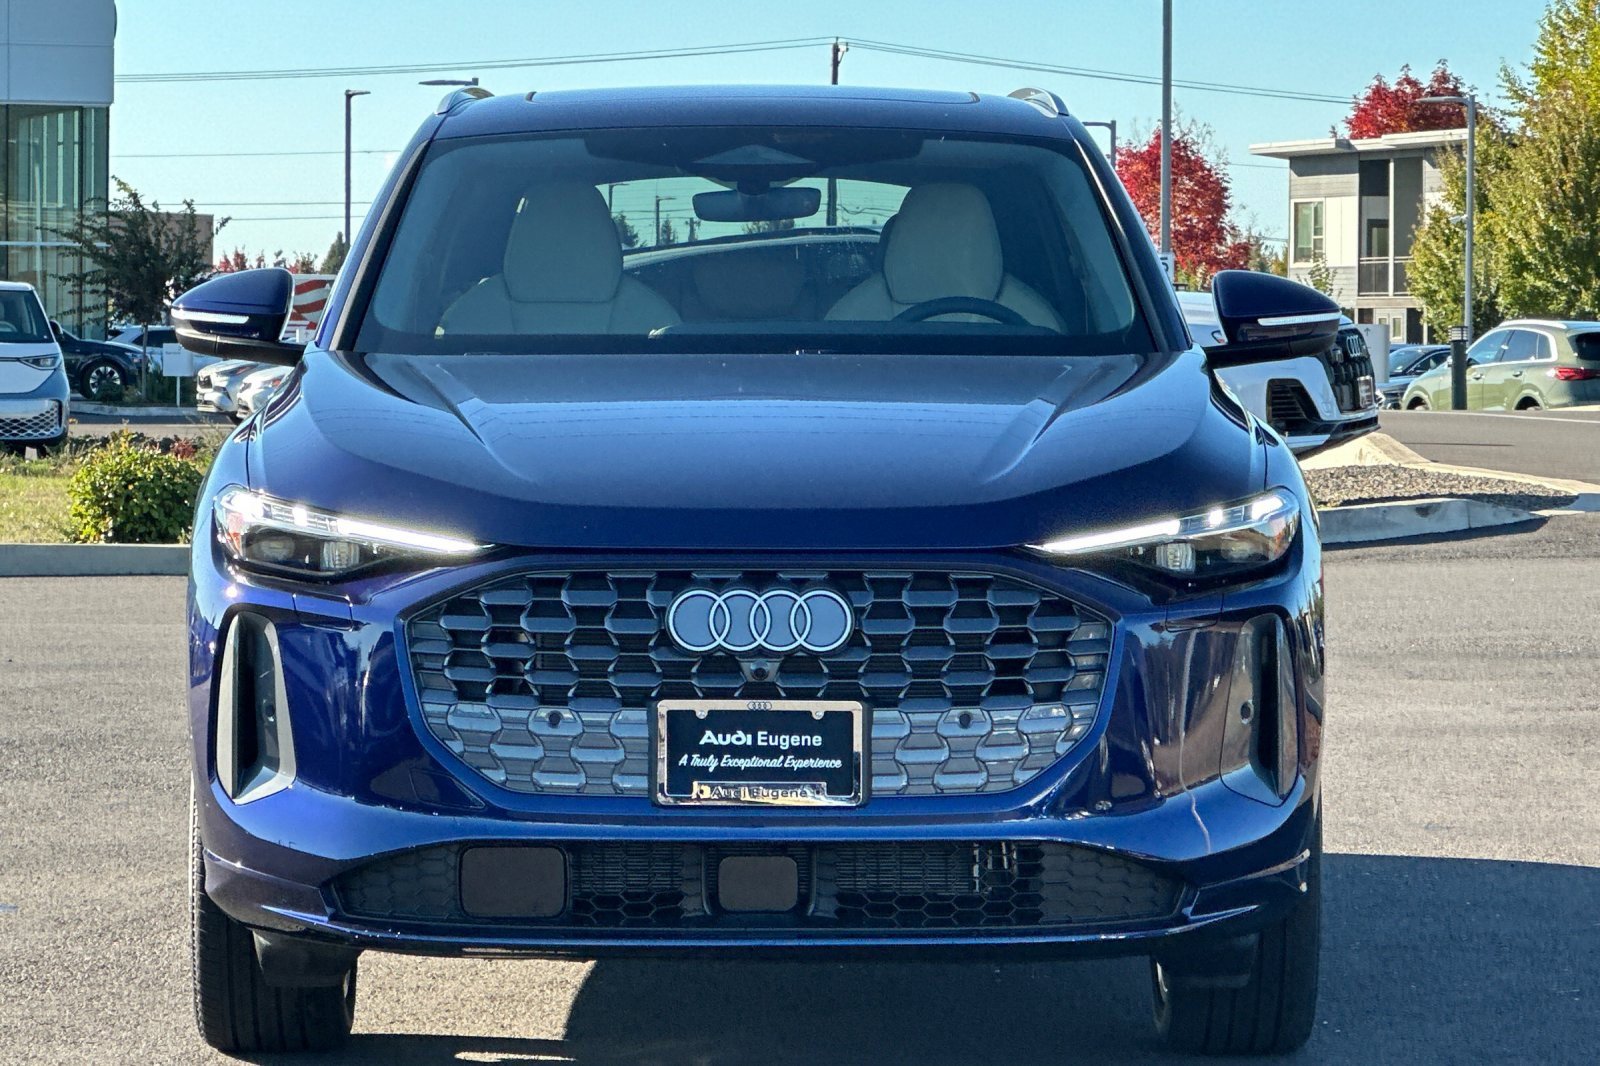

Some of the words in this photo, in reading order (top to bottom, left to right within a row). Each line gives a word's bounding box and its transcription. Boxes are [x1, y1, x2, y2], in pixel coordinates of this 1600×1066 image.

[699, 730, 752, 746] Audi
[757, 731, 823, 749] Eugene
[678, 753, 688, 767] A
[690, 754, 719, 772] Truly
[720, 754, 784, 771] Exceptional
[784, 755, 842, 771] Experience
[711, 786, 747, 799] Audi
[752, 786, 808, 799] Eugene
